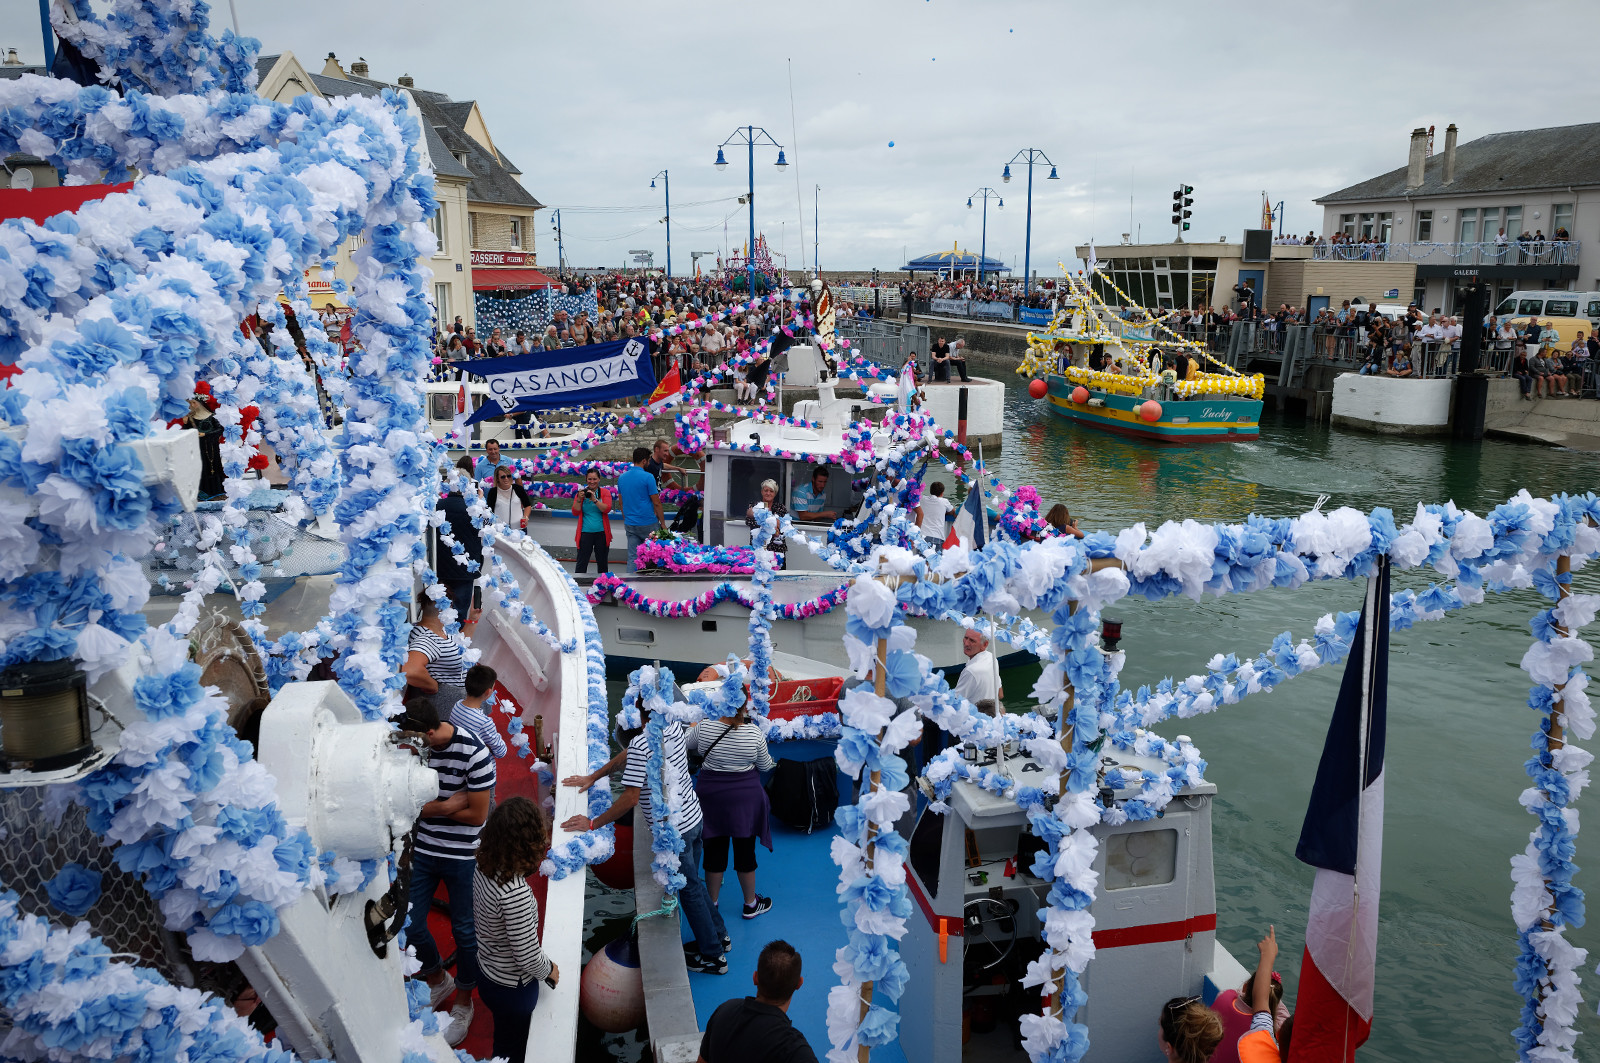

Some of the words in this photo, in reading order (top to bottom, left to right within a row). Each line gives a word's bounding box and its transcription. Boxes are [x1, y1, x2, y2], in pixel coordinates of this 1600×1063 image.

[471, 253, 505, 264] RASSERIE
[490, 359, 635, 396] CASANOVA
[1200, 407, 1233, 421] Lucky
